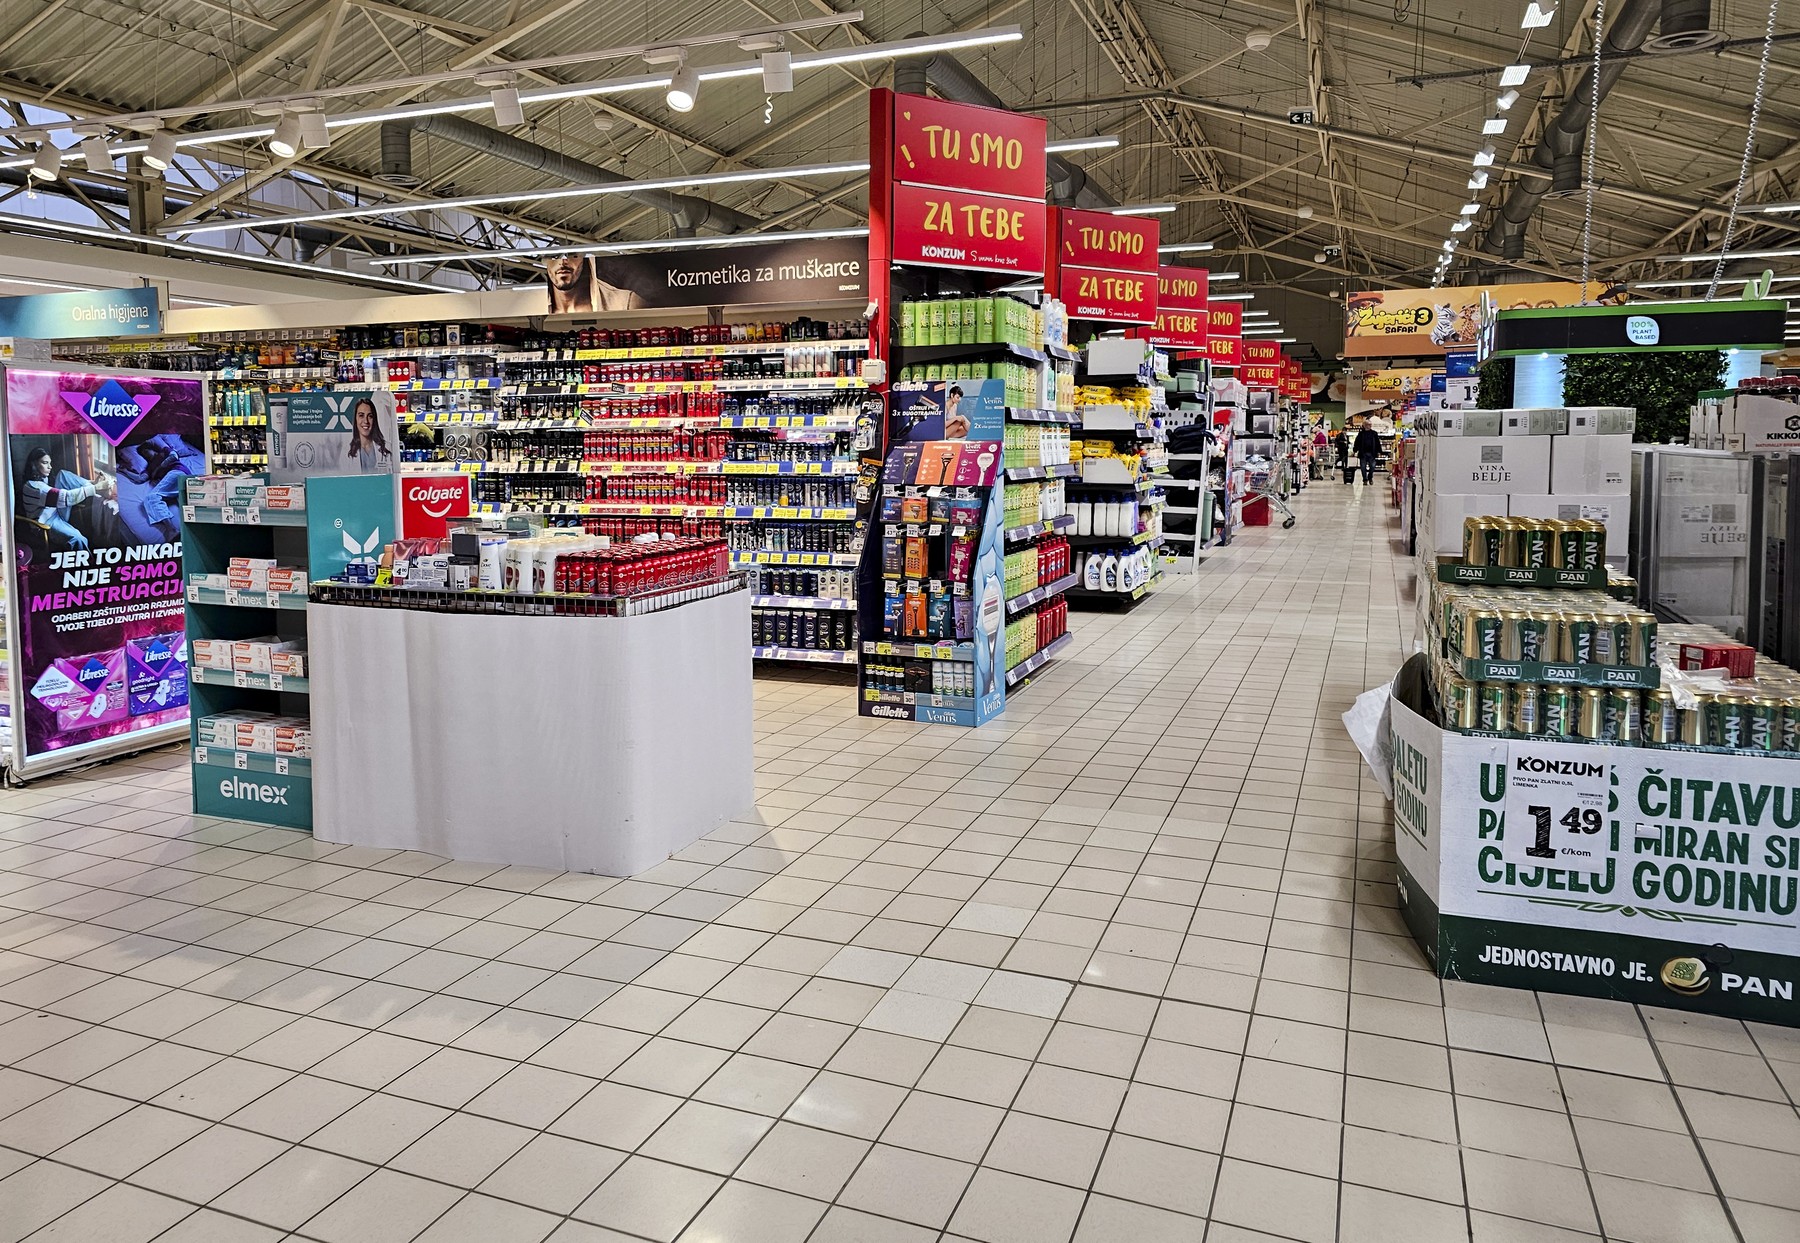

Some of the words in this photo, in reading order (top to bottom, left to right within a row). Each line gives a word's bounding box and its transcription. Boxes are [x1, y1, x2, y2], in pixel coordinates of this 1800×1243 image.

[921, 125, 961, 161] TU
[969, 132, 1023, 170] SMO
[923, 201, 954, 235] ZA
[959, 204, 1025, 241] TEBE
[1079, 227, 1104, 250] TU
[1108, 230, 1144, 255] SMO
[921, 245, 966, 260] KONZUM
[667, 264, 751, 288] Kozmetika
[755, 266, 774, 282] za
[778, 257, 860, 281] muškarce
[1079, 276, 1099, 299] ZA
[1102, 278, 1144, 302] TEBE
[1171, 279, 1198, 297] SMO
[72, 305, 106, 322] Oralna
[108, 304, 149, 323] higijena
[1213, 311, 1233, 326] SMO
[1167, 315, 1198, 333] TEBE
[1384, 325, 1418, 334] SAFARI
[1209, 340, 1234, 355] TEBE
[1247, 347, 1258, 357] TU
[1259, 347, 1275, 358] SMO
[1247, 368, 1256, 378] ZA
[1256, 368, 1274, 379] TEBE
[891, 381, 929, 392] Gillette
[1288, 381, 1297, 391] EBE
[89, 396, 142, 417] Libresse
[1472, 472, 1511, 483] BELJE
[229, 498, 250, 506] elmex
[408, 485, 464, 504] Colgate
[49, 551, 90, 570] JER
[93, 546, 122, 565] TO
[62, 567, 112, 588] NIJE
[270, 571, 289, 579] elmex
[1459, 569, 1483, 577] PAN
[1509, 571, 1533, 579] PAN
[1560, 573, 1585, 581] PAN
[31, 578, 184, 613] MENSTRUACIJ
[238, 593, 262, 606] lmex
[51, 610, 92, 624] ODABERI
[92, 605, 126, 618] ZAŠTITU
[127, 603, 150, 613] KOJA
[55, 622, 85, 633] TVOJE
[85, 617, 114, 629] TIJELO
[114, 612, 151, 624] IZNUTRA
[144, 650, 173, 663] Libresse
[79, 668, 110, 682] Libresse
[1489, 667, 1517, 676] PAN
[1547, 669, 1575, 678] PAN
[1607, 672, 1636, 681] PAN
[871, 705, 910, 719] Gillette
[982, 699, 1001, 716] Venus
[926, 709, 957, 723] Venus
[1516, 756, 1604, 778] KONZUM
[220, 775, 289, 806] elmex
[1512, 781, 1538, 789] LIMENKA
[1637, 767, 1800, 830] ČITAVU
[1396, 779, 1428, 838] GODINU
[1561, 848, 1592, 857] €/kom
[1634, 822, 1749, 865] MIRAN
[1764, 834, 1800, 870] SI
[1632, 860, 1798, 916] GODINU
[1478, 945, 1616, 977] JEDNOSTAVNO
[1621, 961, 1654, 983] JE.
[1721, 972, 1793, 1000] PAN
